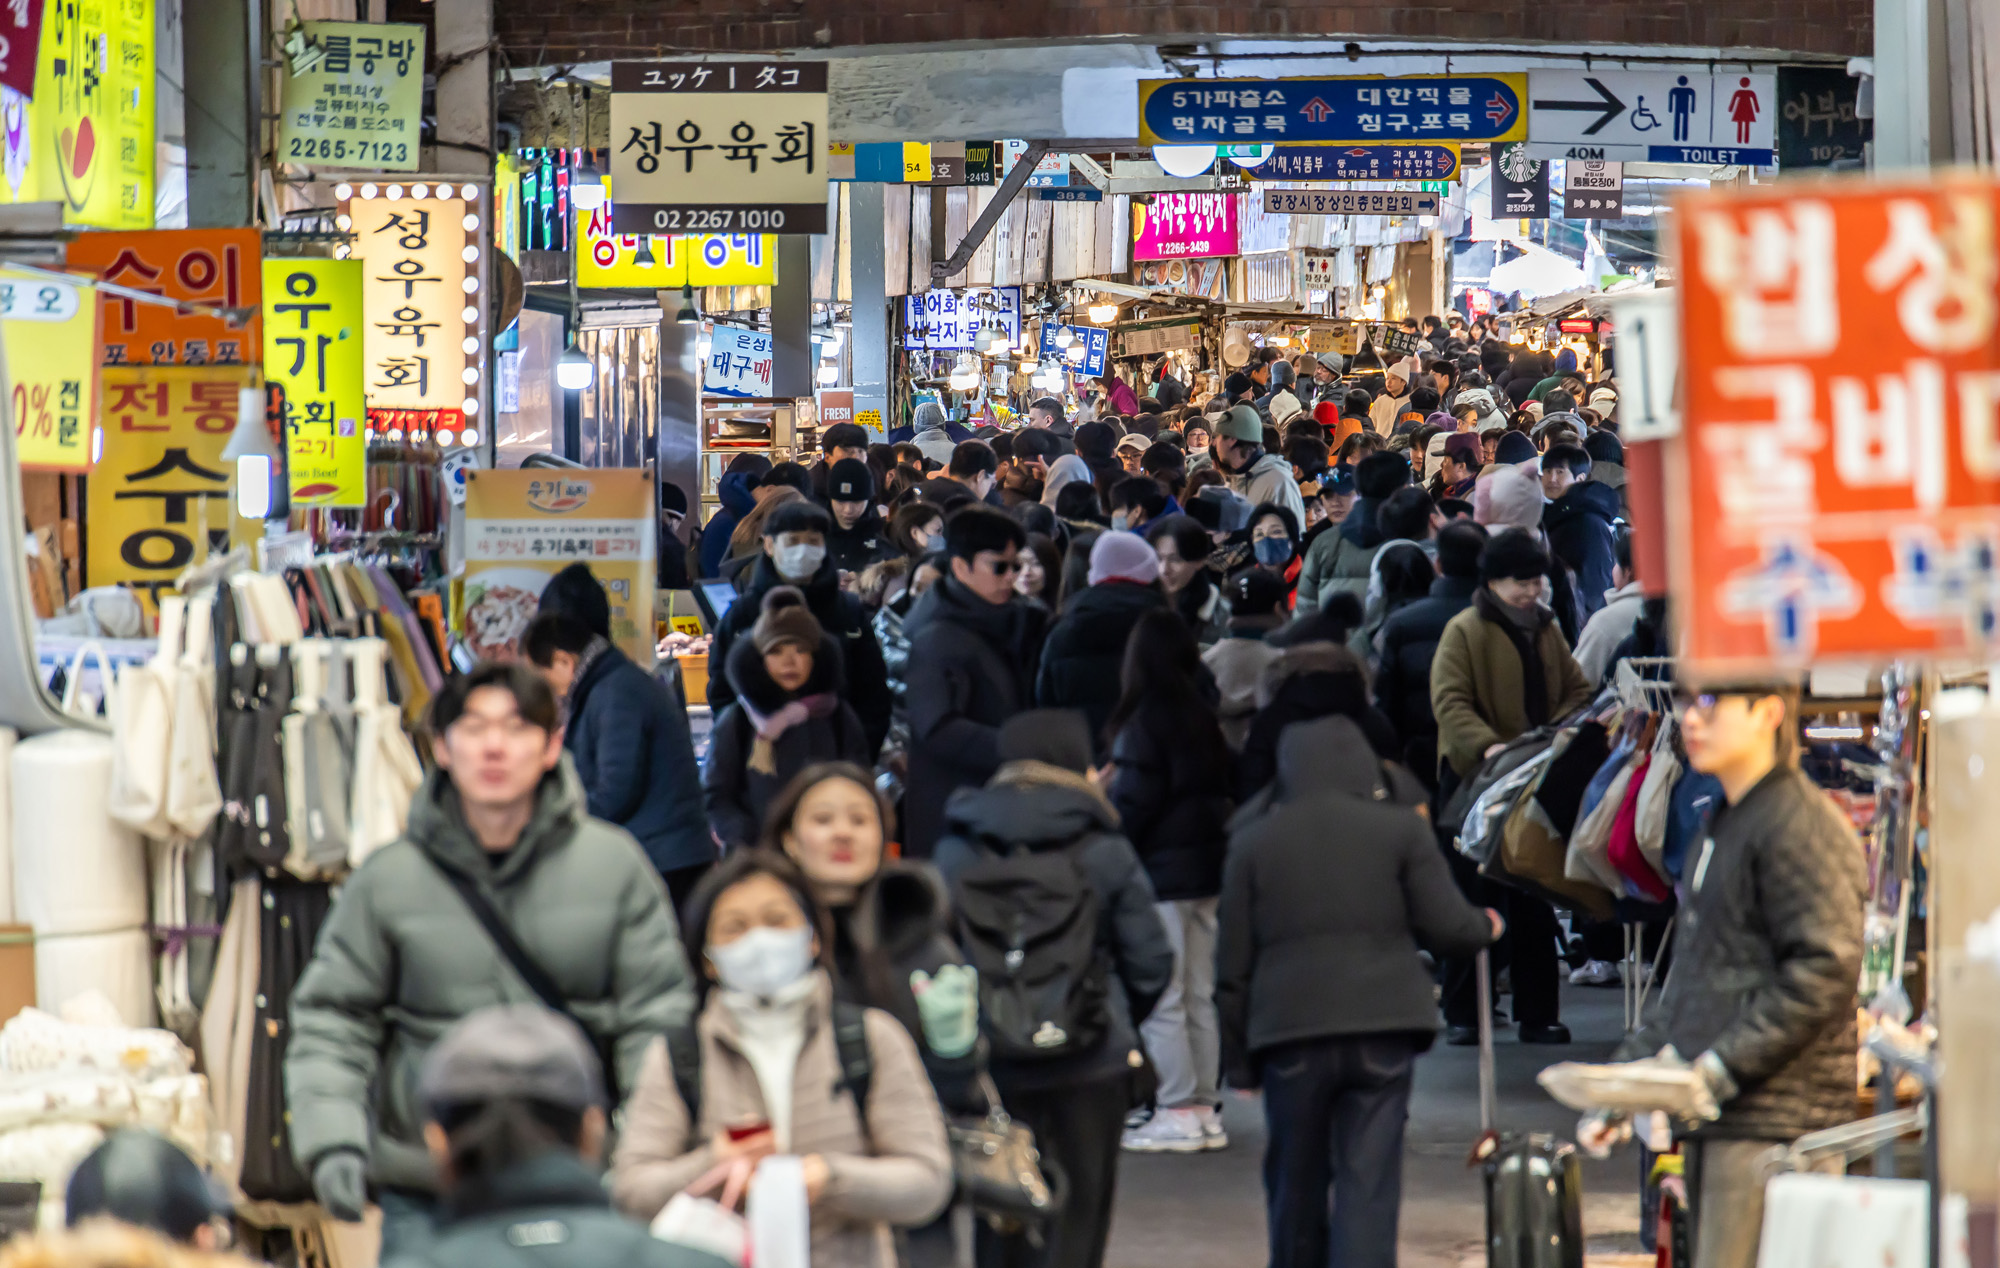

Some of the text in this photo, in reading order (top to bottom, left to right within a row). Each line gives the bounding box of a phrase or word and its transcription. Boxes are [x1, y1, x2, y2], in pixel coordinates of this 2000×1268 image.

[641, 67, 800, 88] ユッケ タコ
[1172, 89, 1287, 108] 5가파출소
[1357, 87, 1472, 106] 대한직물
[1172, 116, 1287, 134] 먹자골목
[290, 137, 408, 162] 2265-7123
[620, 119, 815, 174] 성우육회
[1566, 147, 1605, 160] 40M
[1681, 149, 1739, 165] TOILET
[1271, 194, 1412, 212] 광장시장상인총연합회
[654, 209, 785, 229] 02 2267 1010
[373, 209, 443, 398] 성우육회
[1089, 333, 1104, 372] 전복
[110, 382, 241, 434] 전통
[824, 407, 851, 421] FRESH
